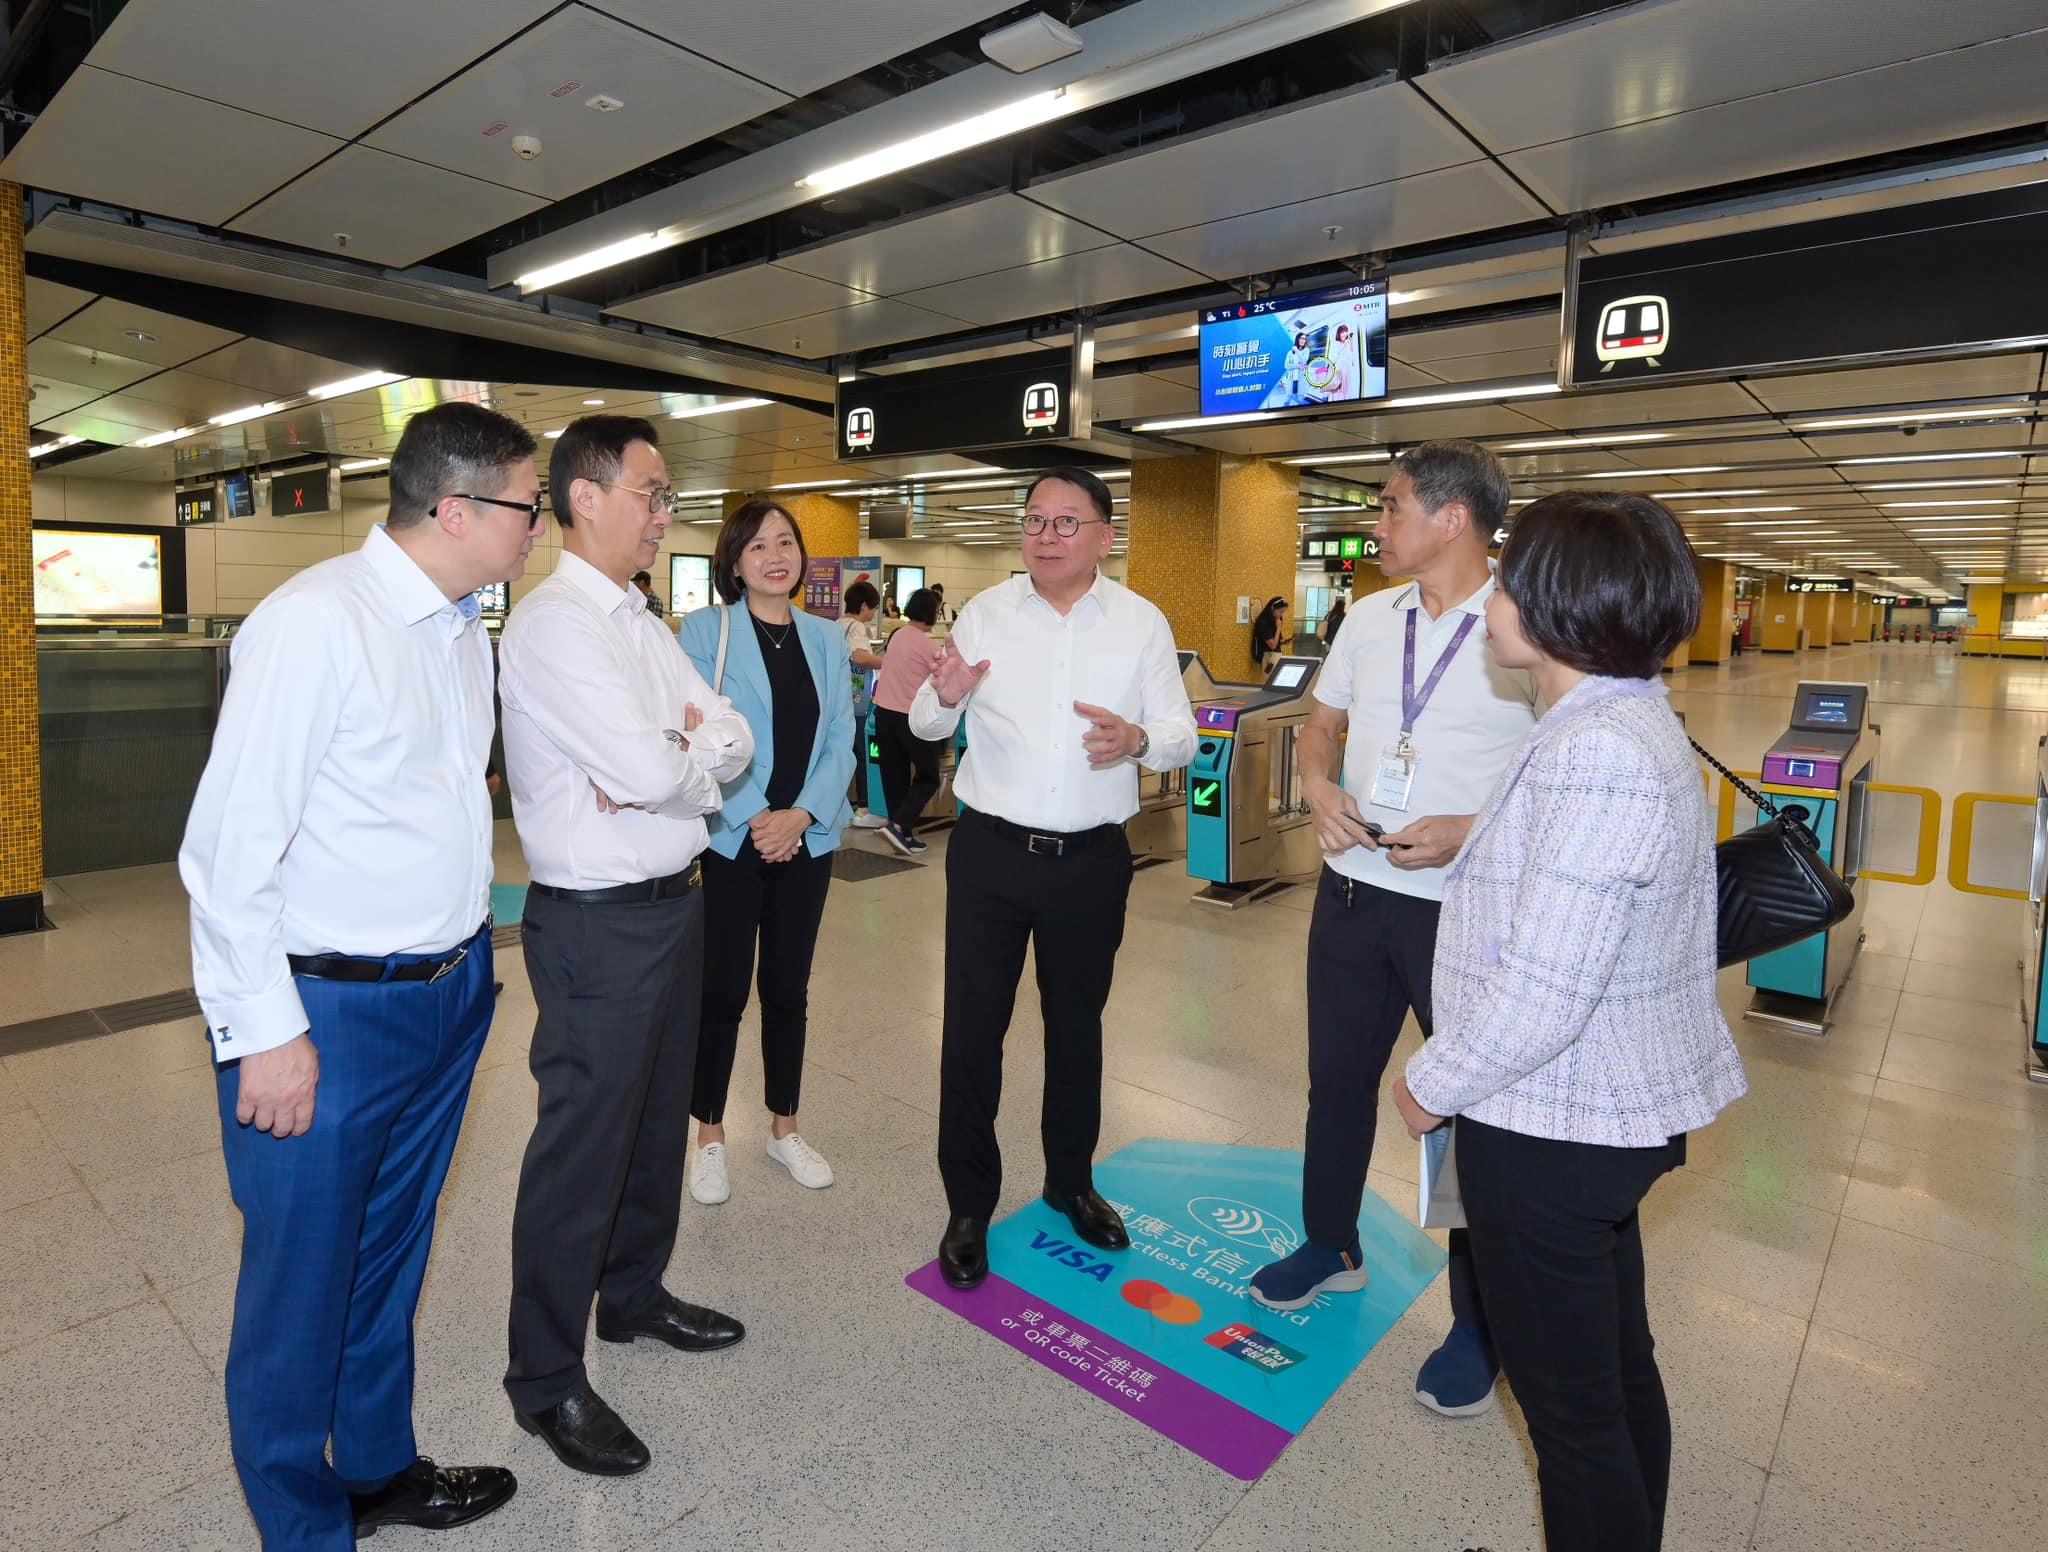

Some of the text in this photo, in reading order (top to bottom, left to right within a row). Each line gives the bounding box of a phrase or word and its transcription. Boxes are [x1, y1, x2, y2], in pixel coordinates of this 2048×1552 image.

[1349, 283, 1375, 296] 10:05
[1254, 303, 1265, 313] 25
[1363, 301, 1381, 309] MTR
[1222, 352, 1271, 372] 小心扒手
[1030, 1227, 1115, 1284] VISA
[1192, 1267, 1249, 1300] Bank
[1223, 1327, 1294, 1366] UnionPay
[1000, 1317, 1146, 1403] or QR code Ticket
